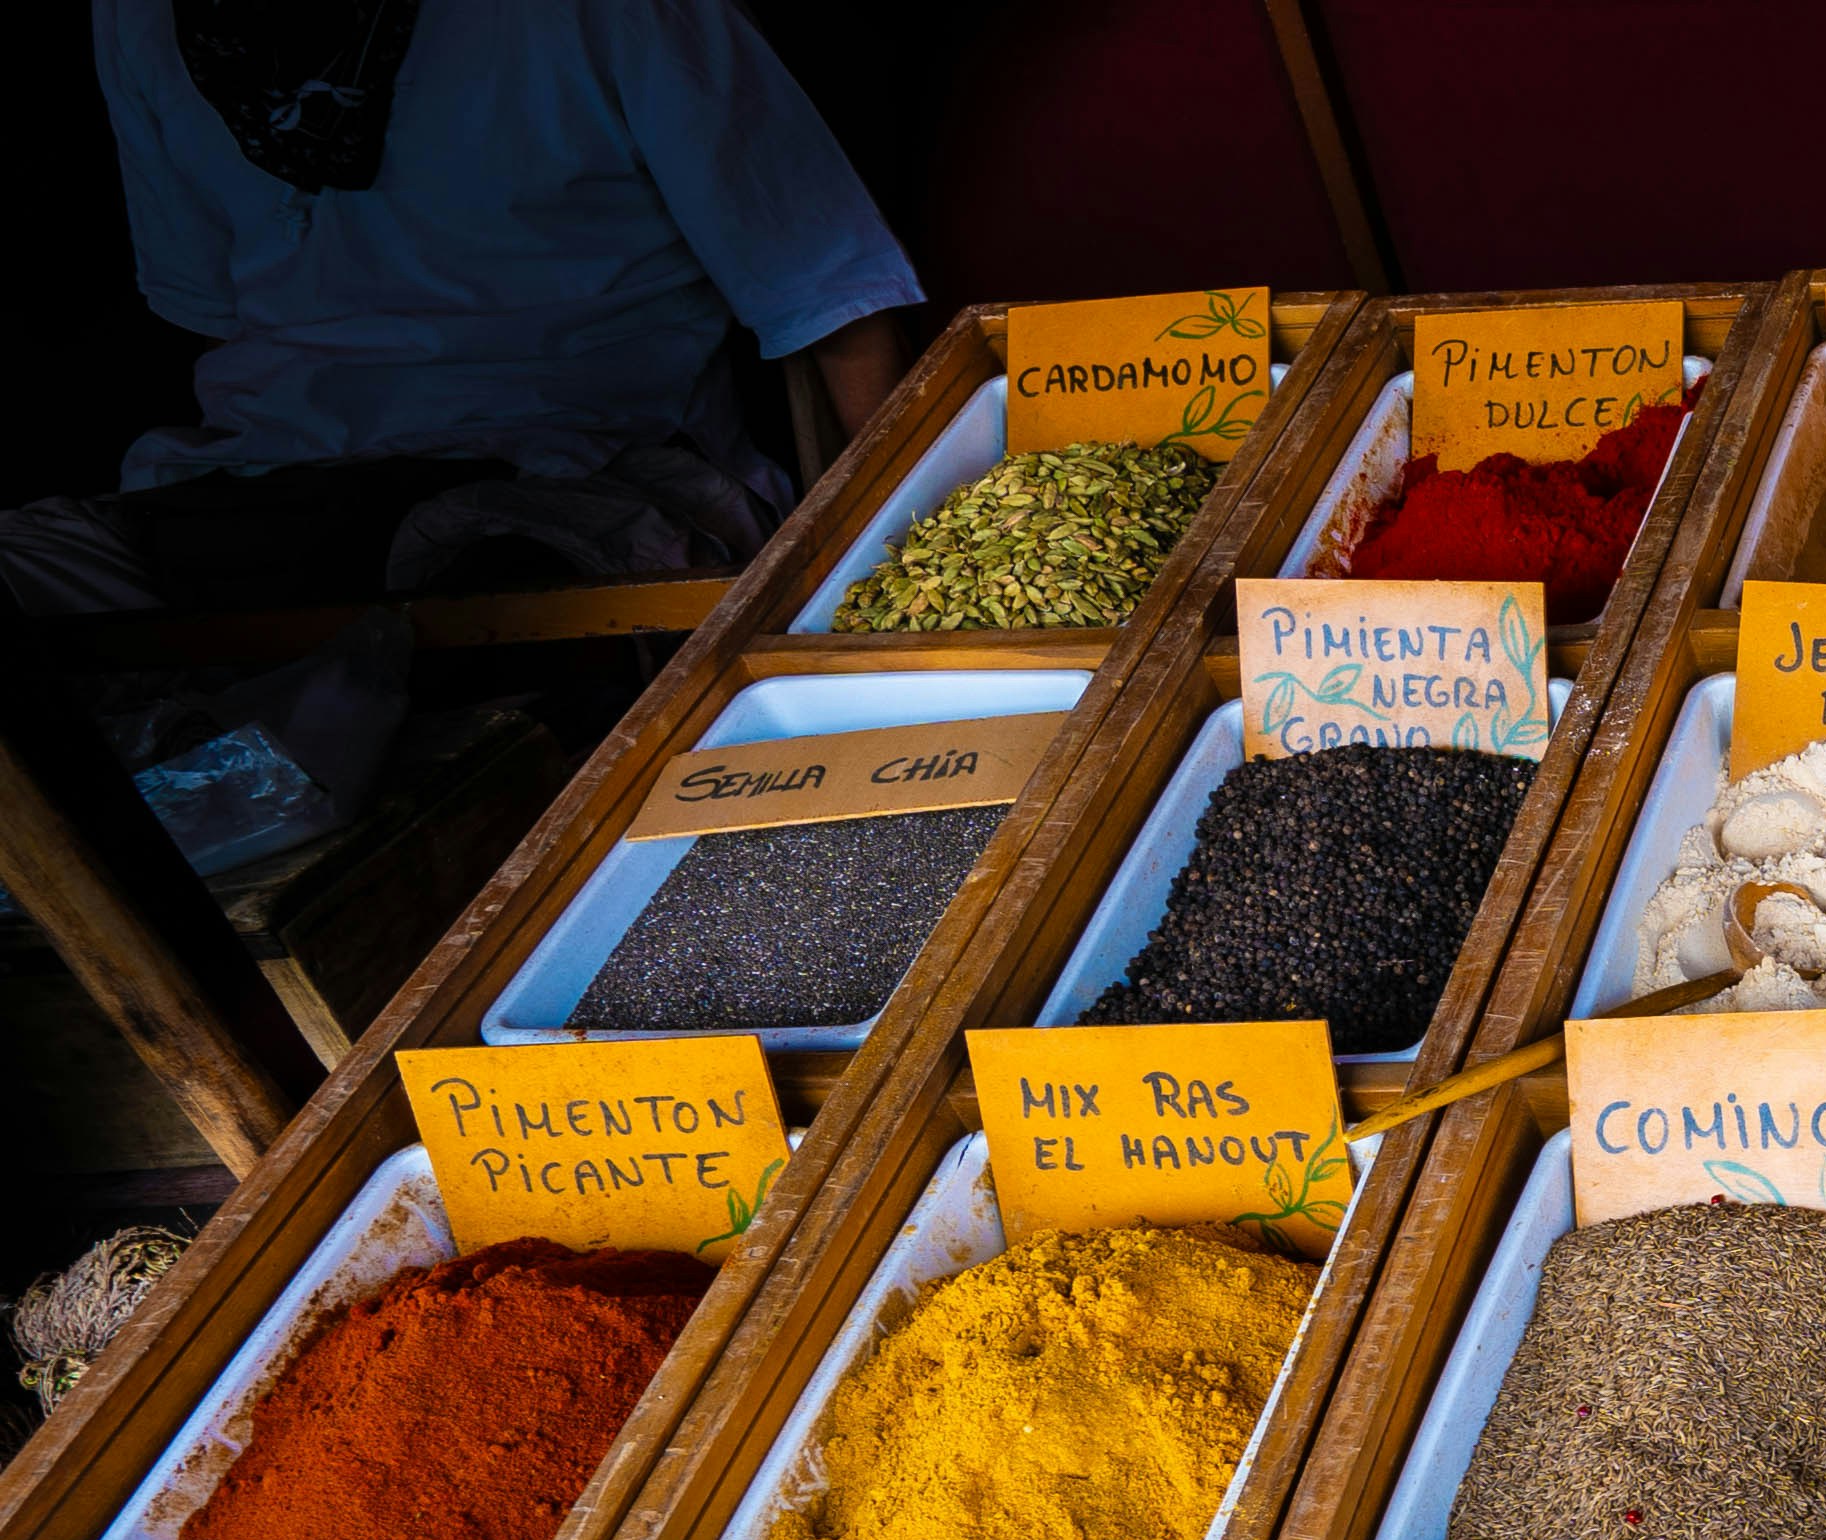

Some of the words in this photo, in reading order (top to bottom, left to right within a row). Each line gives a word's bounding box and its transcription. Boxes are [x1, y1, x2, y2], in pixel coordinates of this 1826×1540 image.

[1017, 354, 1259, 399] CARDAMOMO
[1432, 339, 1671, 388] PIMENTON
[1485, 398, 1622, 430] DULCE
[1262, 606, 1492, 664] PIMIENTA
[1371, 674, 1509, 709] NEGRA
[675, 765, 827, 802] SEMILLA
[430, 1077, 748, 1140] PIMENTON
[1019, 1078, 1102, 1120] MIX
[1142, 1071, 1252, 1119] RAS
[470, 1148, 733, 1197] PICANTE
[1035, 1135, 1086, 1173] EL
[1122, 1131, 1313, 1170] HANOUT
